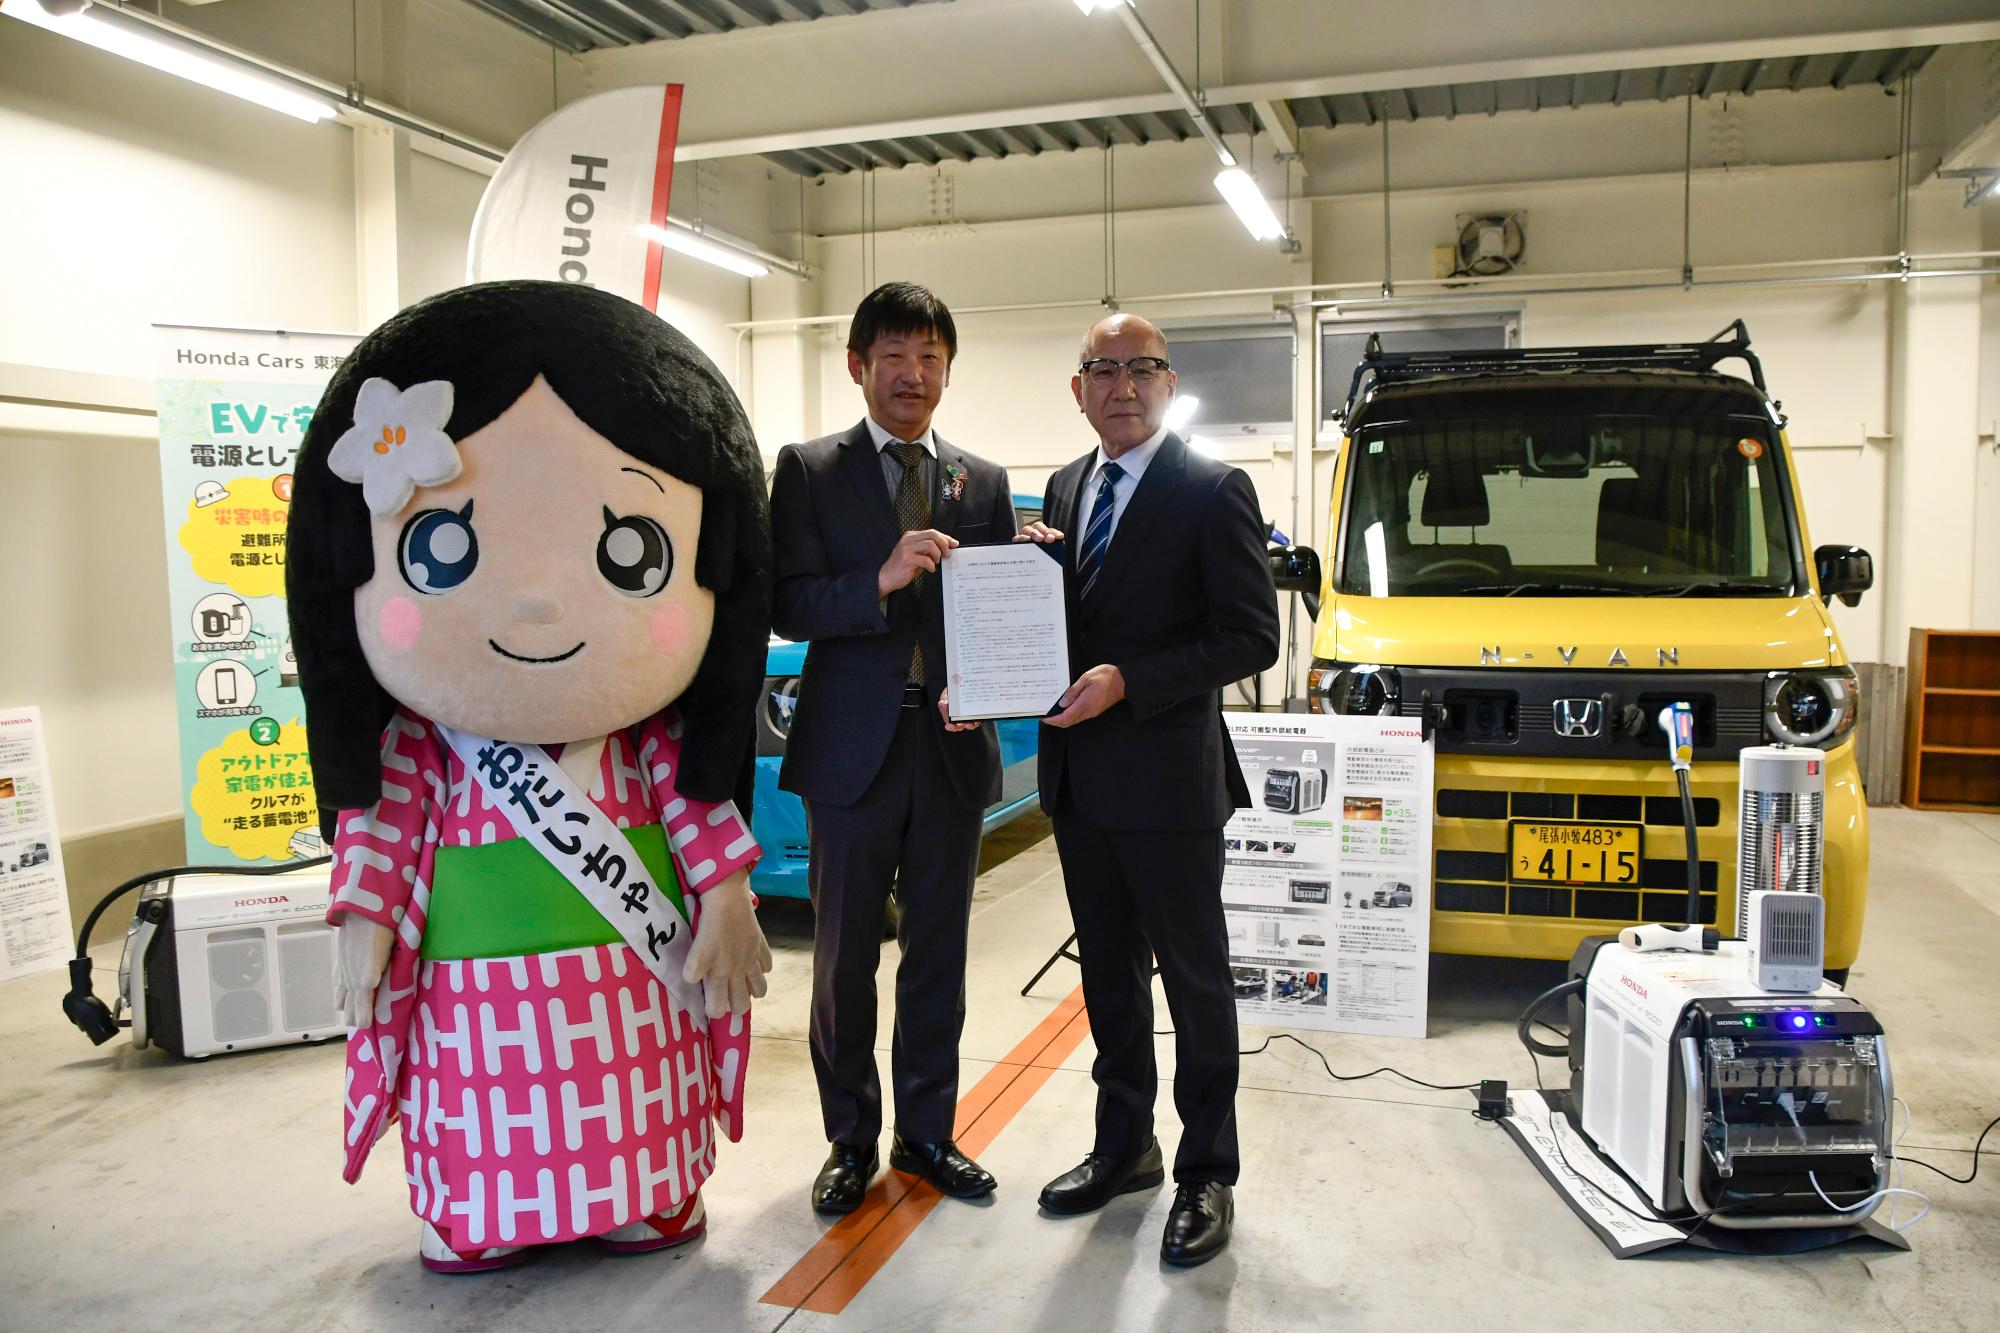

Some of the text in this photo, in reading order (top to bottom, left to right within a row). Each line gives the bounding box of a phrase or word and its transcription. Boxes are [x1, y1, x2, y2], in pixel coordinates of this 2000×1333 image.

[177, 349, 249, 367] Honda
[257, 353, 304, 369] Cars
[214, 508, 288, 526] 災害時の
[241, 533, 286, 547] 避難所
[230, 552, 285, 567] 電源とし
[1481, 646, 1679, 666] N-VAN
[259, 727, 272, 742] 2
[225, 771, 312, 793] 家電が使え
[250, 793, 306, 809] クルマが
[477, 740, 676, 961] おだいちゃん
[1520, 848, 1635, 882] う 41-15
[234, 896, 289, 907] HONDA
[1620, 975, 1648, 999] HONDA
